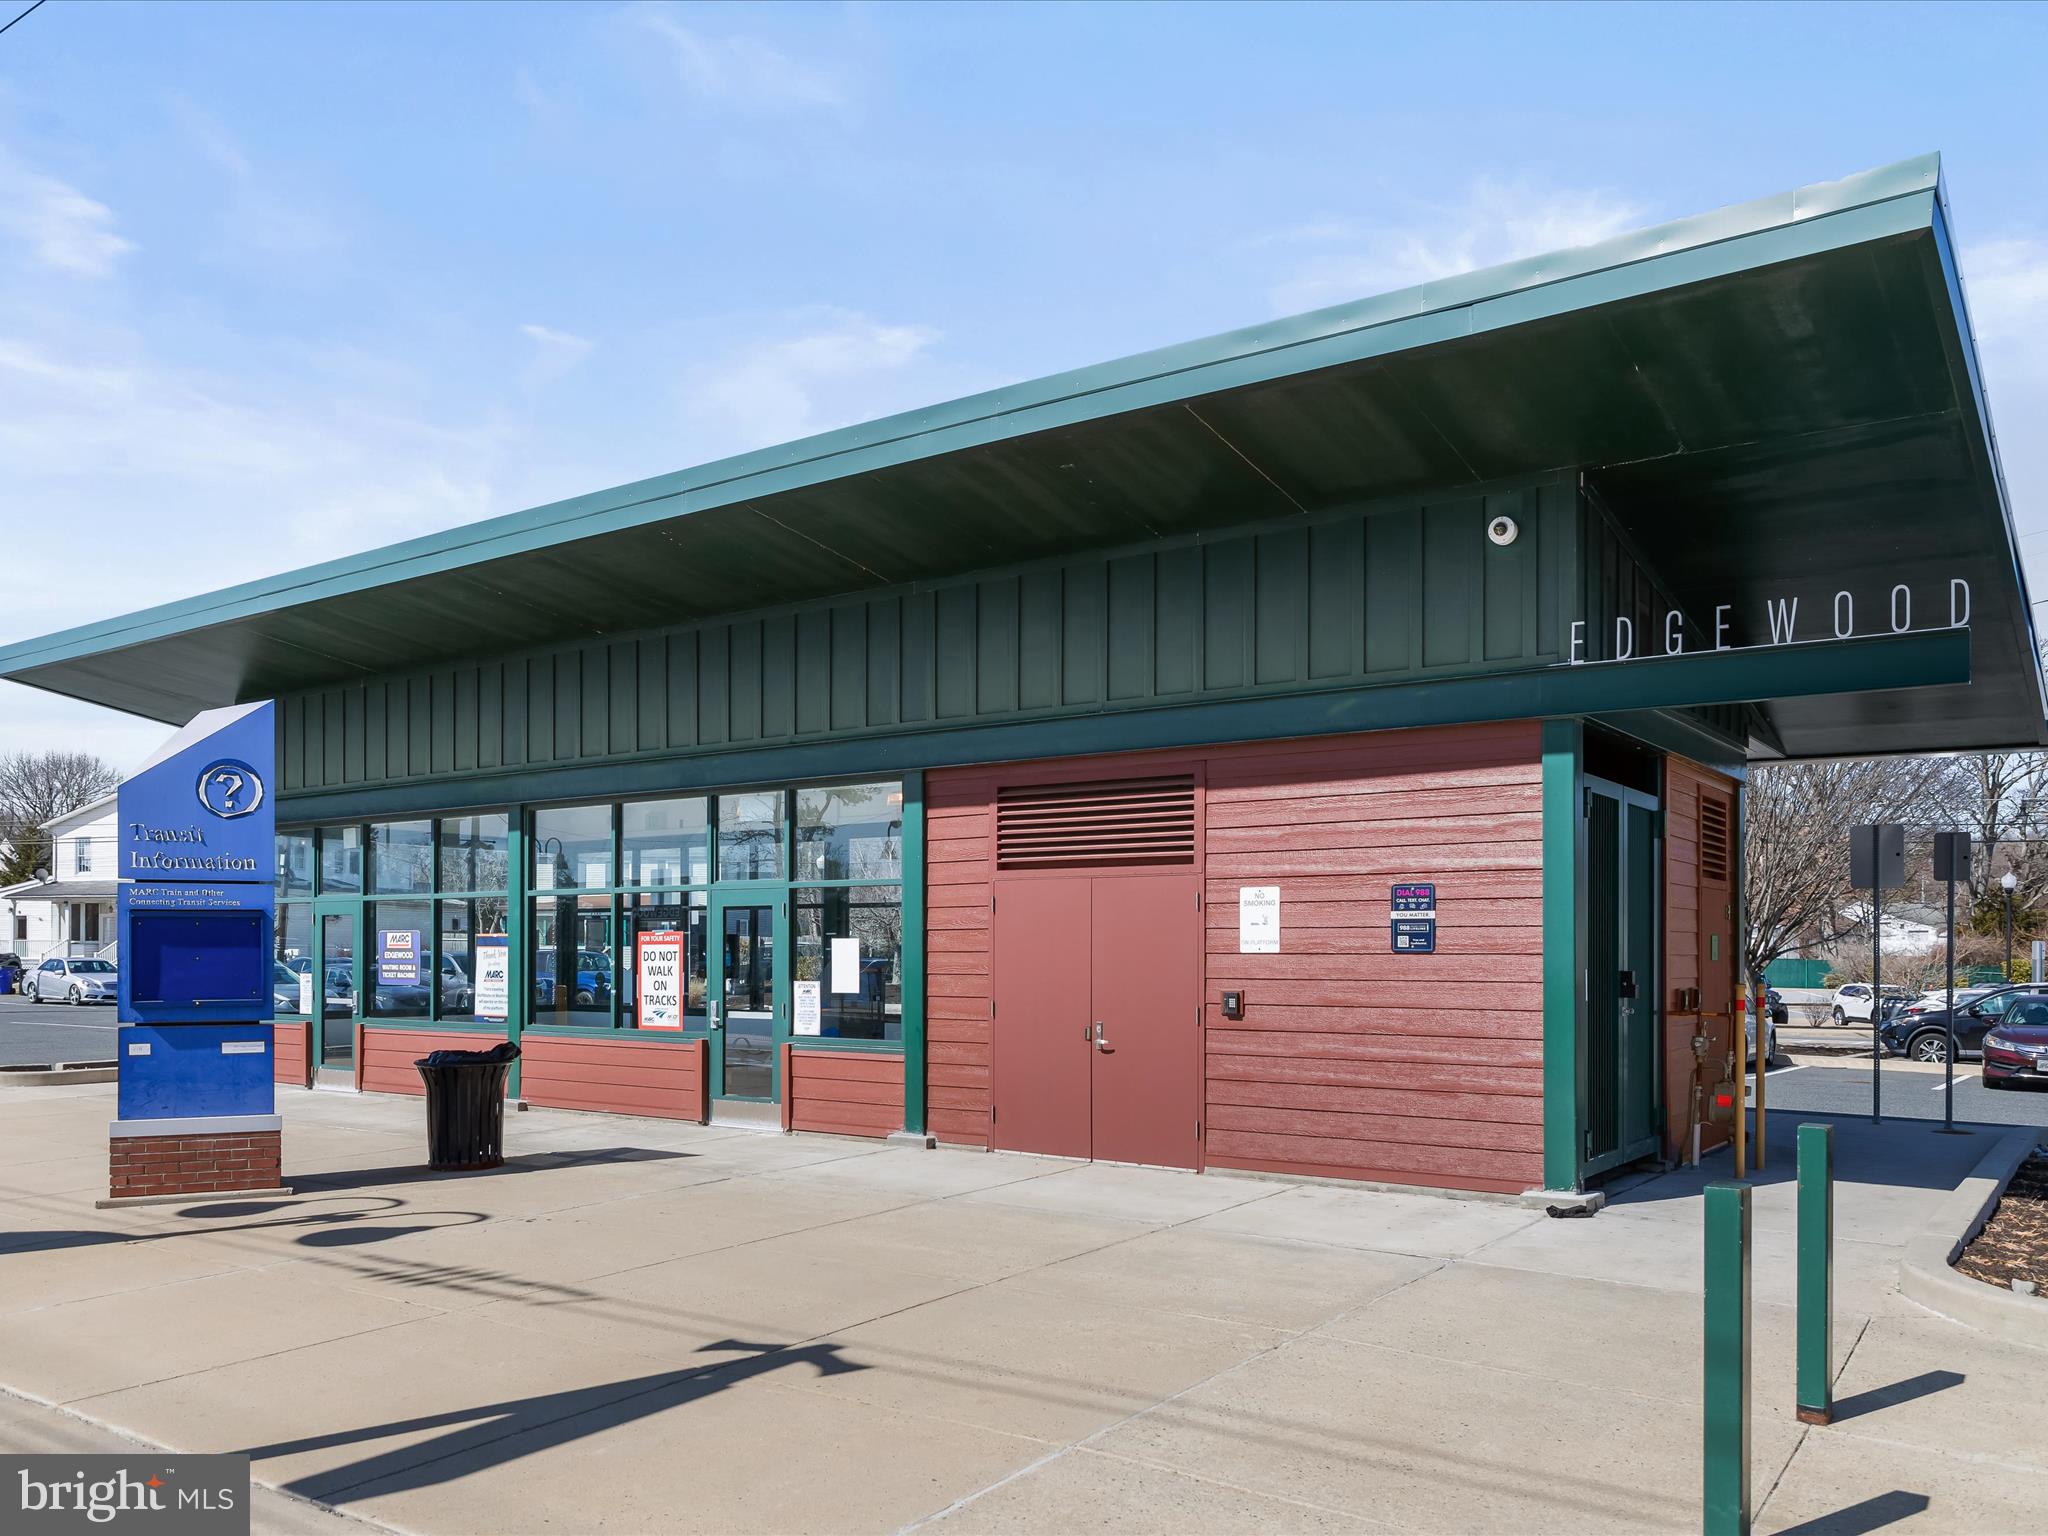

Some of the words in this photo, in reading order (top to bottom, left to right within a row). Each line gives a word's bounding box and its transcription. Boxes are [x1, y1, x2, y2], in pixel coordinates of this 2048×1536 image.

[1570, 578, 1970, 666] EDGEWOOD
[129, 823, 204, 842] Transit
[130, 850, 257, 871] Information
[129, 888, 159, 896] MARC
[161, 888, 182, 896] Train
[202, 889, 224, 897] Other
[129, 898, 175, 907] Connecting
[178, 898, 205, 906] Transit
[389, 934, 410, 943] MARC
[384, 951, 414, 959] EDGEWOOD
[643, 951, 656, 962] DO
[659, 951, 678, 962] NOT
[484, 970, 504, 979] MARC
[647, 965, 673, 976] WALK
[653, 980, 667, 991] ON
[643, 994, 677, 1006] TRACKS
